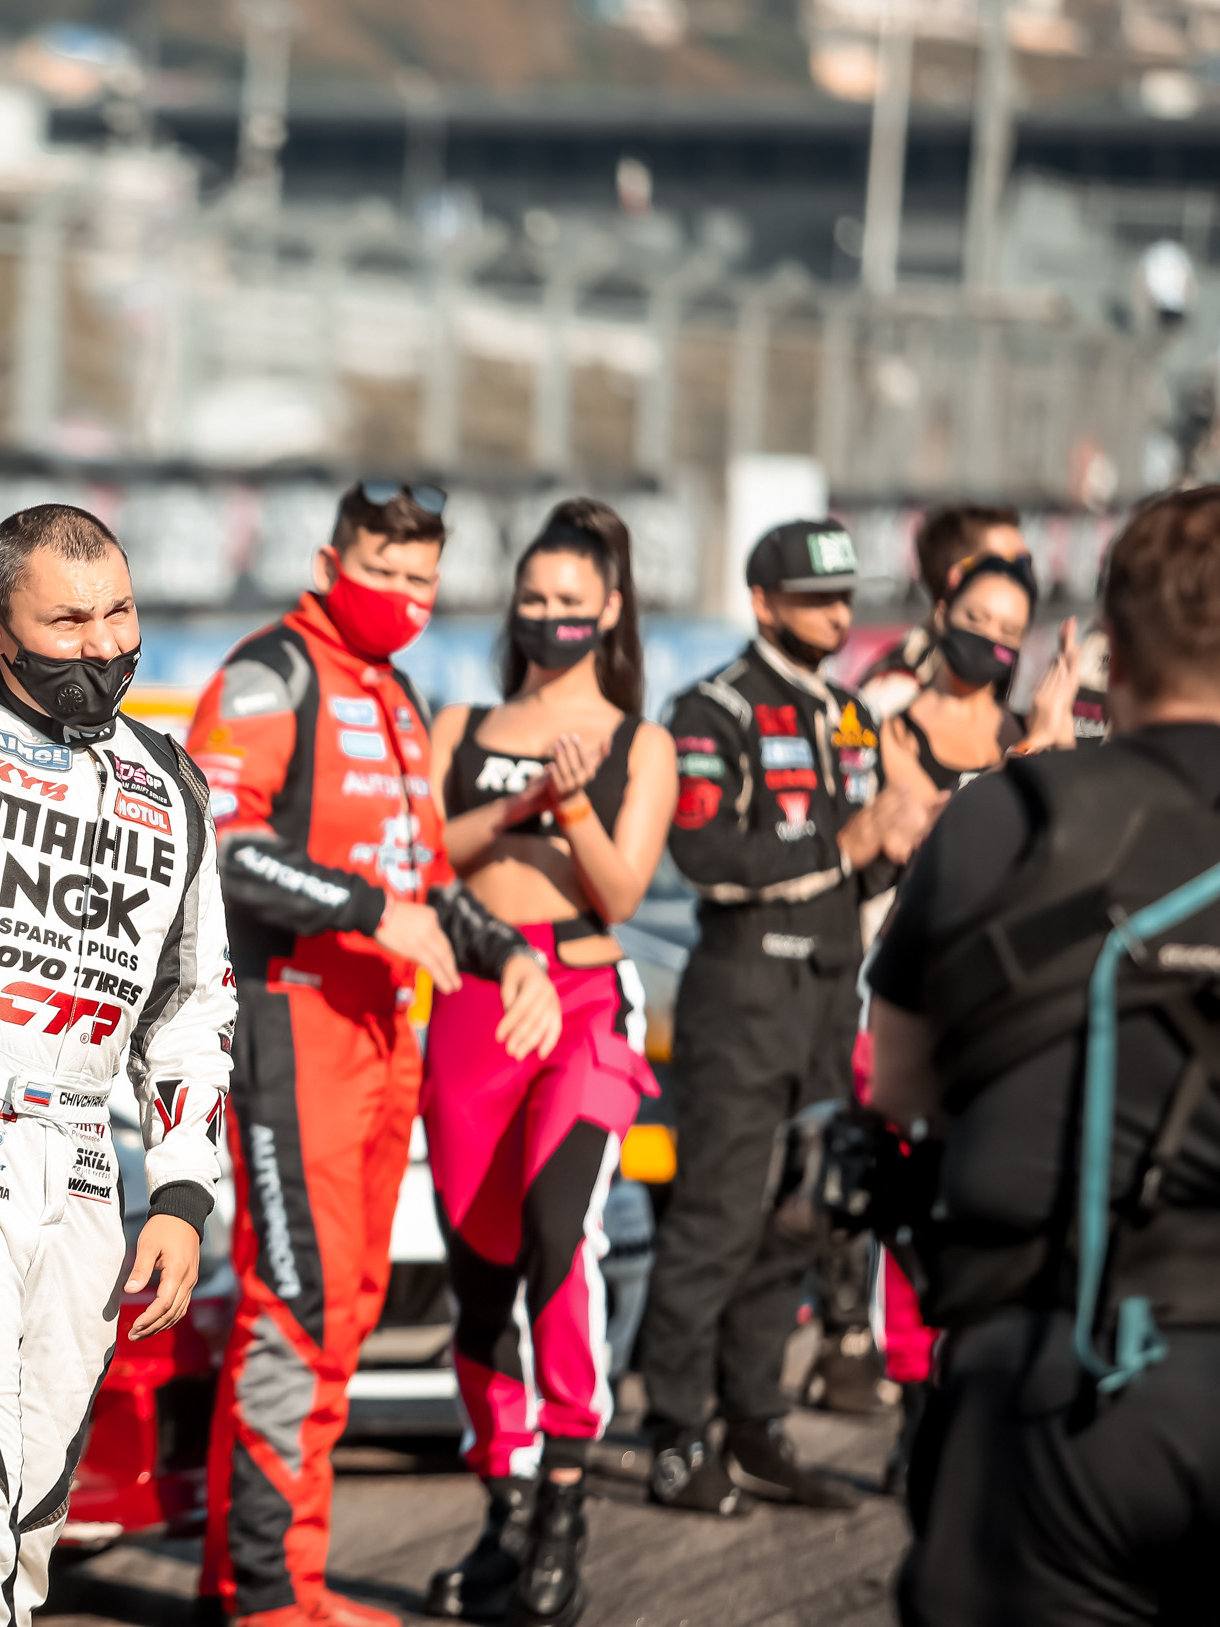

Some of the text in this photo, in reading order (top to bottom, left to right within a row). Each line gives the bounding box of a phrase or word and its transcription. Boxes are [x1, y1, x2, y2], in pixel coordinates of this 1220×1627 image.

[117, 798, 168, 830] MOTUL
[78, 940, 139, 971] PLUGS
[75, 965, 143, 1007] TIRES
[76, 1147, 111, 1172] SKILL
